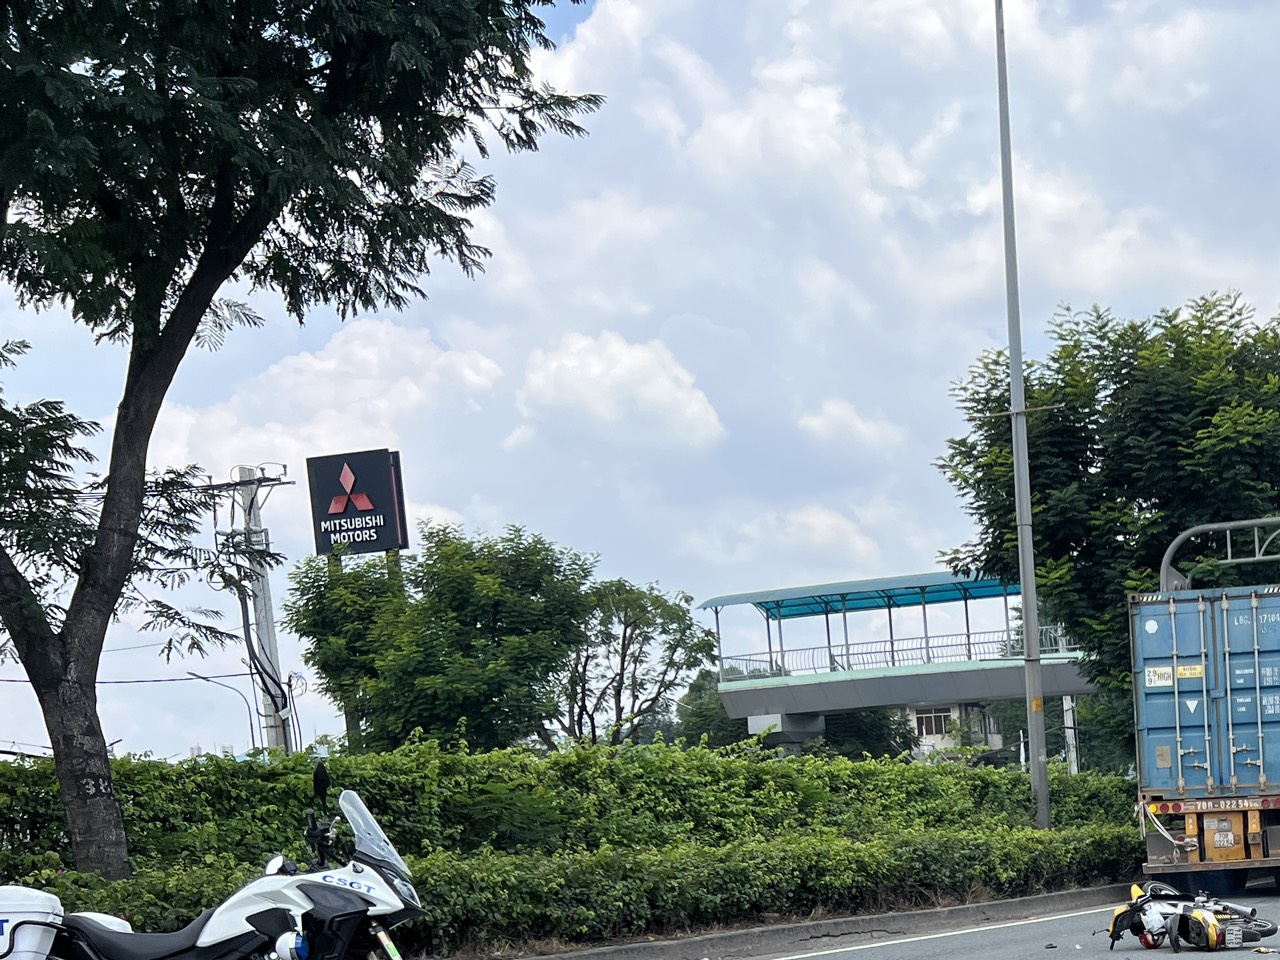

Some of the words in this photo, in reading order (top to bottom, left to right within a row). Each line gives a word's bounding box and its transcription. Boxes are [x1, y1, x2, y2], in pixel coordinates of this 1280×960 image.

[320, 514, 384, 532] MITSUBISHI
[330, 529, 377, 544] MOTORS
[322, 875, 376, 894] CSGT
